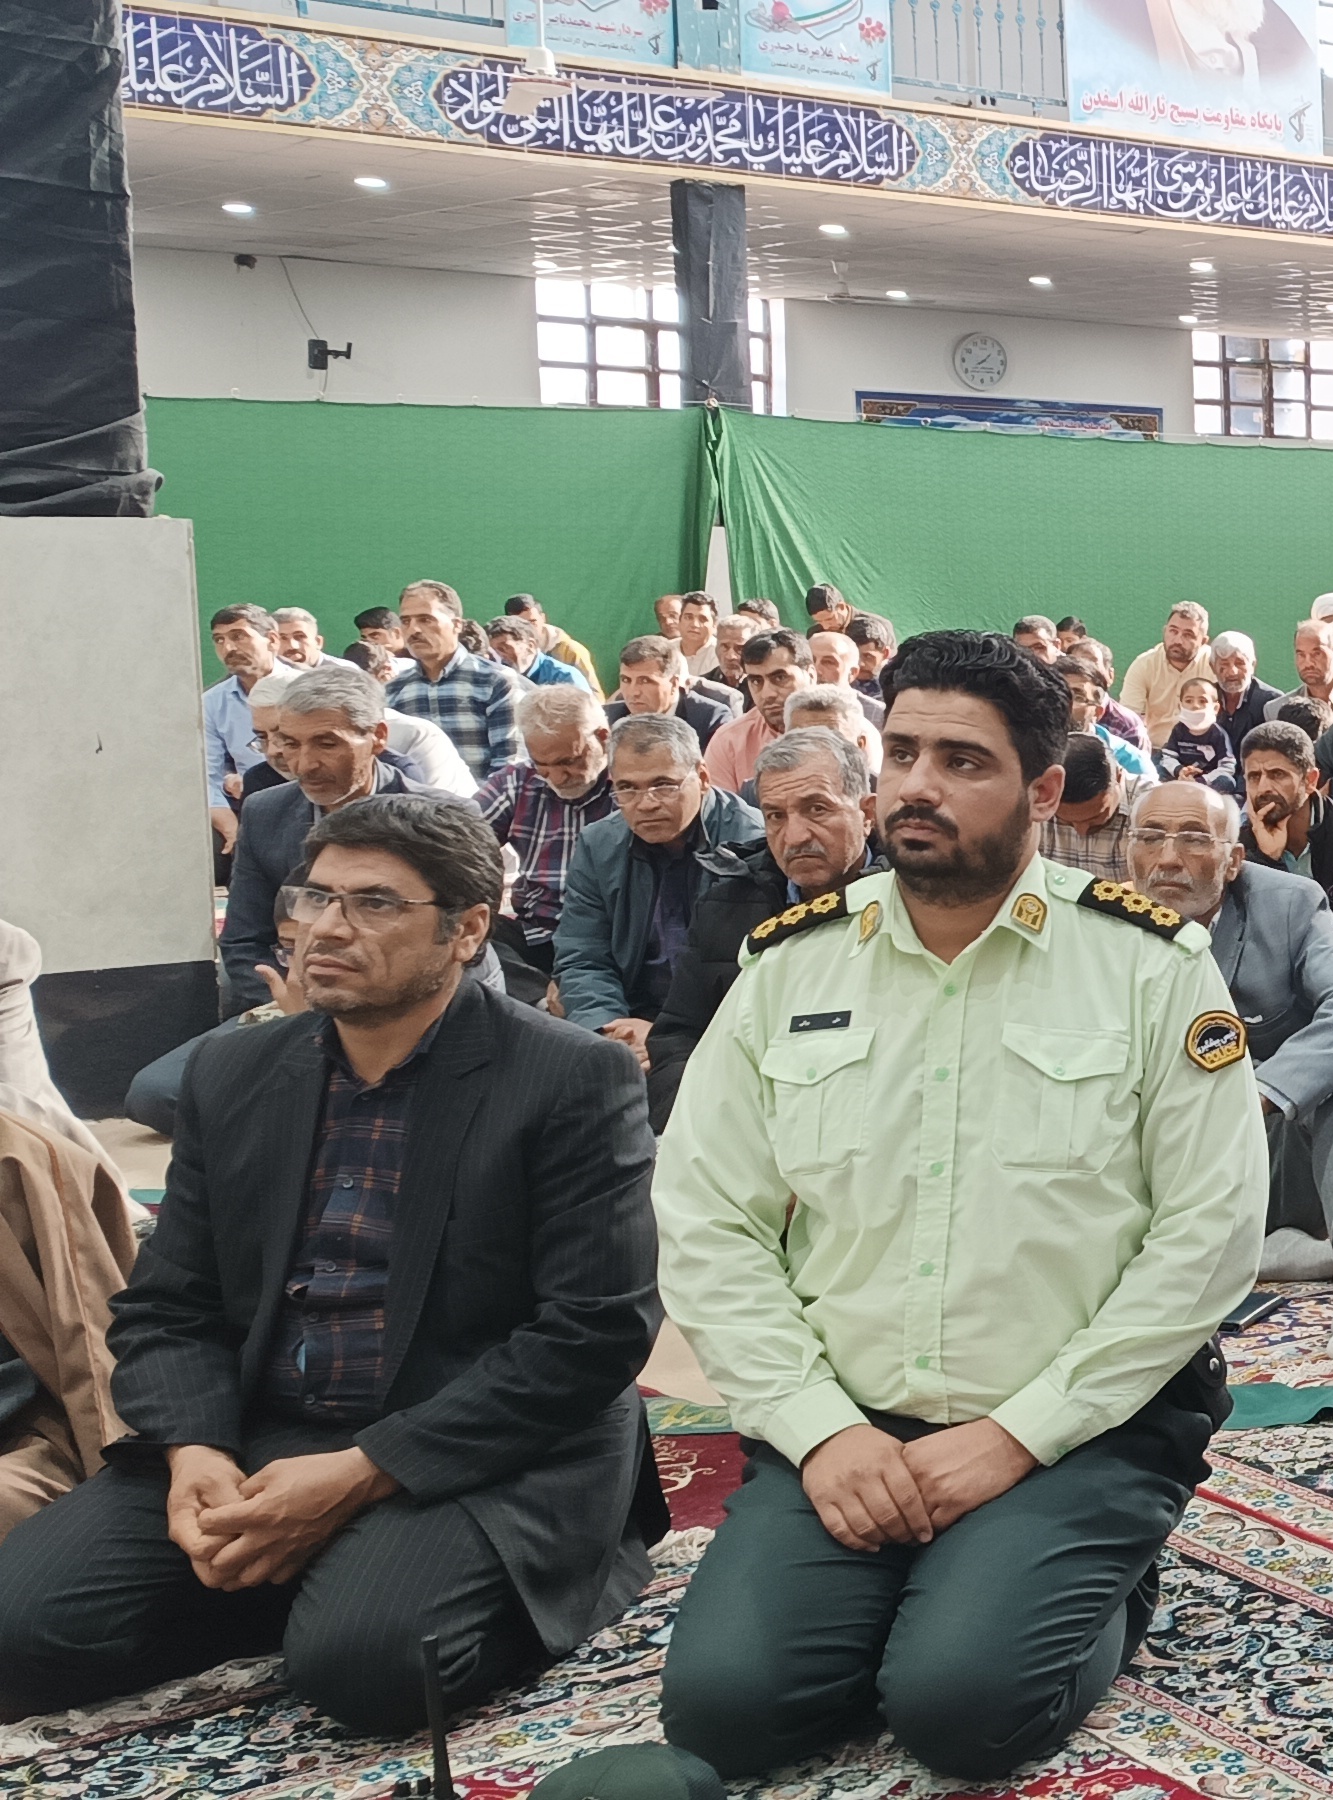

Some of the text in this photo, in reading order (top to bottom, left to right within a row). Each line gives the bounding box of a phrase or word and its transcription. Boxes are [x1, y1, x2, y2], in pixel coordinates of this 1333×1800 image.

[1170, 103, 1199, 123] بسیج
[1203, 107, 1247, 131] مقاومت
[1250, 111, 1283, 132] پایگاه
[1202, 1041, 1239, 1064] POLICE
